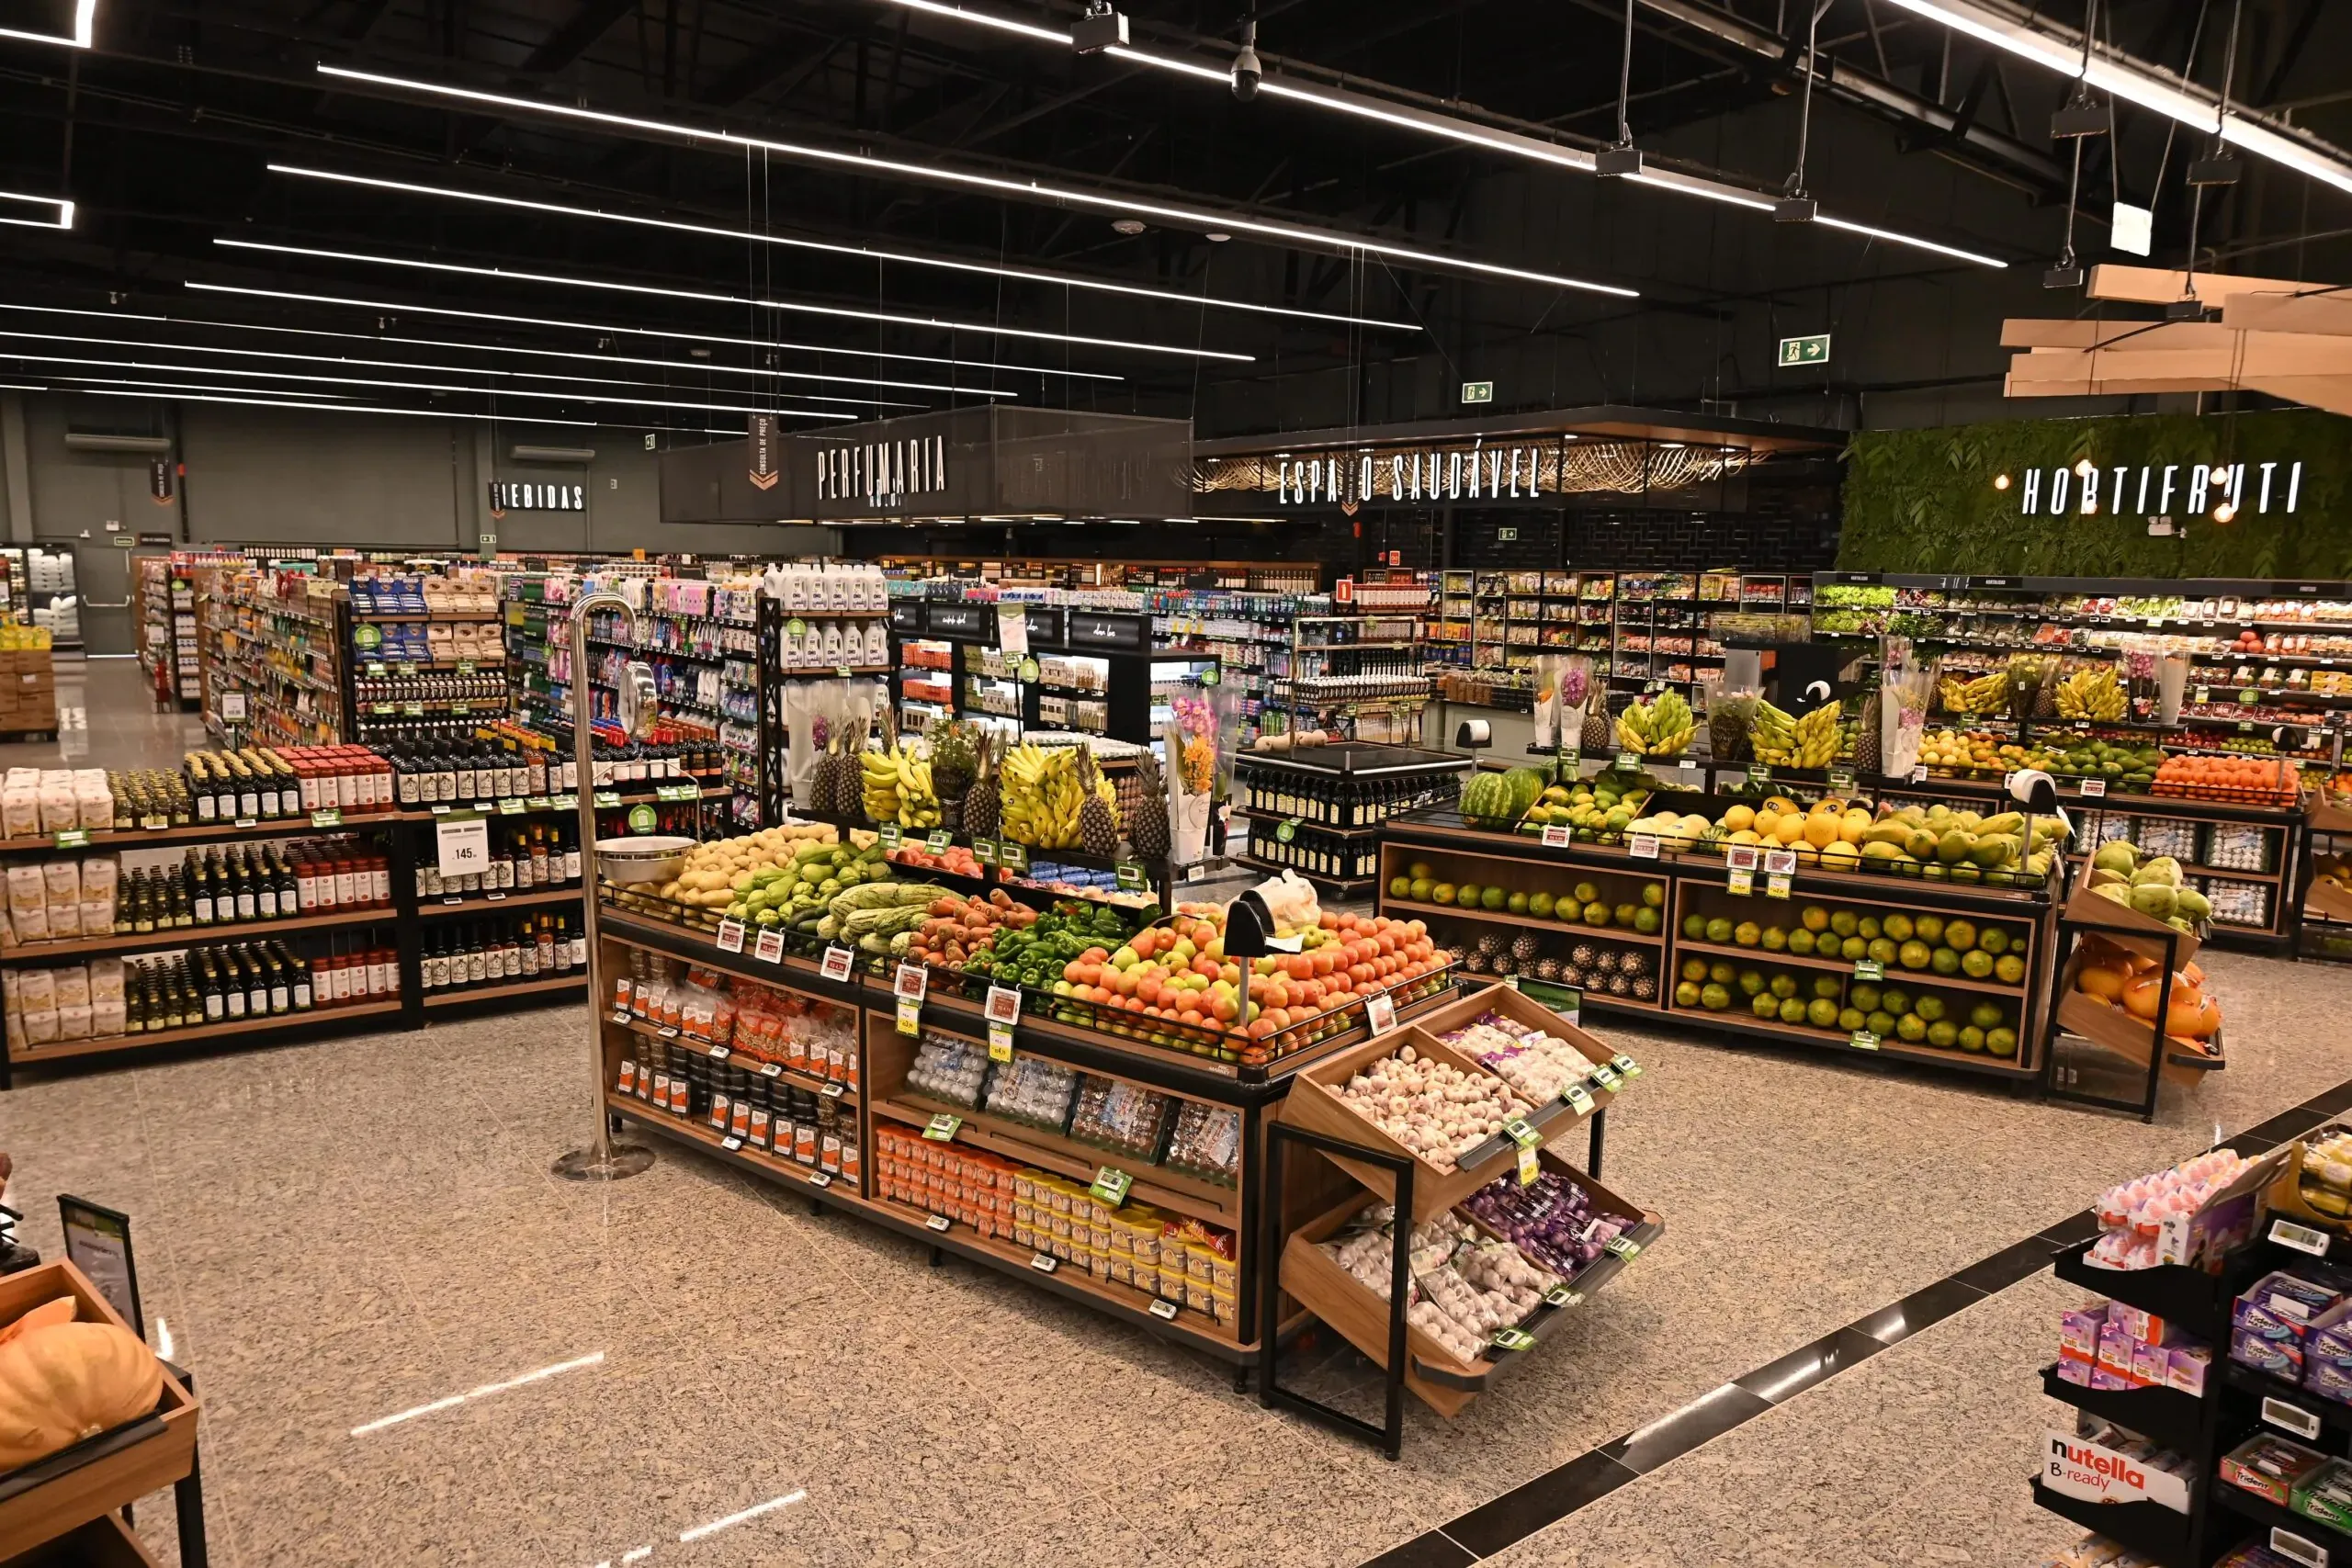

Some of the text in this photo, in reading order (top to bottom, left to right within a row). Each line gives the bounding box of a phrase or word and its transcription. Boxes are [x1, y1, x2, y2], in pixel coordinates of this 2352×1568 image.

[759, 418, 768, 475] CONSULTA DE PREÇO
[817, 434, 945, 501] PERFUMARIA
[1280, 438, 1540, 504] ESPAO SAUDÁVEL
[2022, 461, 2302, 515] HORTIFRUTI
[456, 847, 472, 860] 145
[2245, 1309, 2280, 1331] Trident
[2051, 1461, 2110, 1493] B-ready
[2052, 1438, 2144, 1490] nutella
[2236, 1471, 2268, 1489] Trident
[2306, 1501, 2341, 1521] Trident
